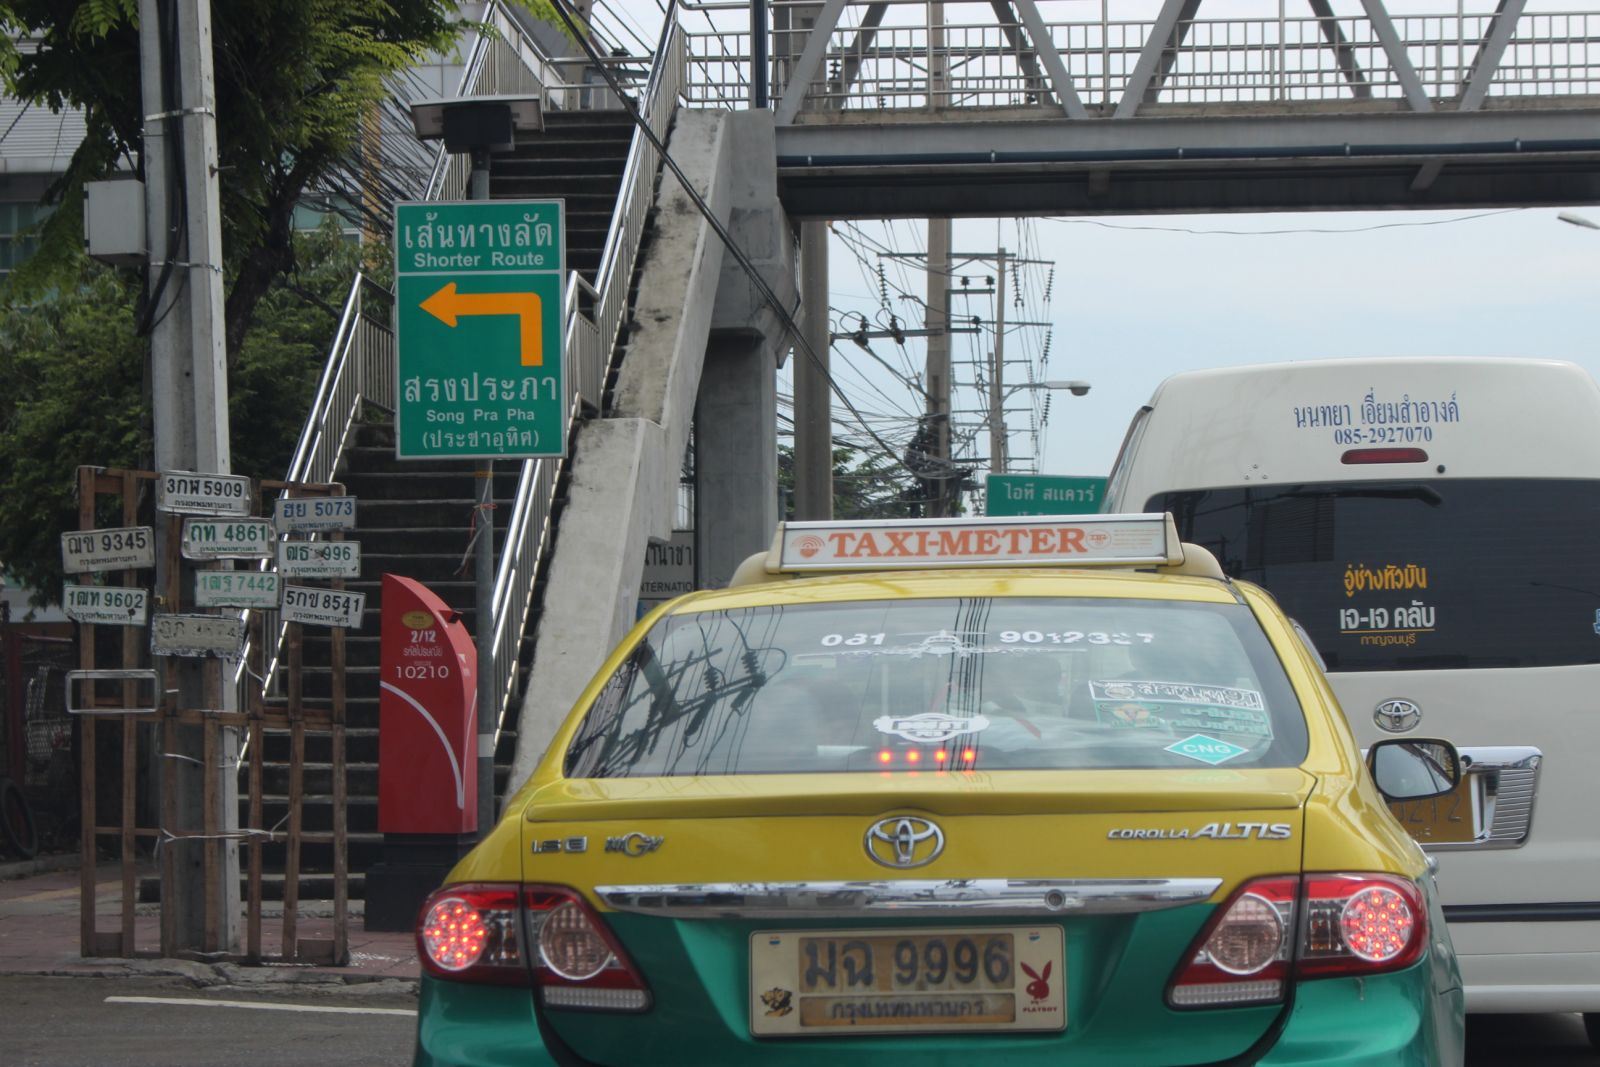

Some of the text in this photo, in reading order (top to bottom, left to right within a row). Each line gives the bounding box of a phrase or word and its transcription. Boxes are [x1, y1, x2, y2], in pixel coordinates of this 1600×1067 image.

[405, 212, 553, 248] เส้นทางลัด
[414, 251, 545, 268] Shorter Route
[404, 372, 557, 402] สรงประภา
[426, 408, 535, 424] Song Pra Pha
[1293, 387, 1460, 428] นนทยา เอี่ยมสำอางค์
[1334, 426, 1433, 444] 085-2927070
[203, 481, 243, 497] 5909
[1002, 482, 1096, 502] ไอที สแควร์
[315, 501, 353, 516] 5073
[223, 524, 267, 541] 4861
[101, 532, 147, 551] 9345
[828, 527, 1088, 558] TAXI-METER
[237, 576, 275, 592] 7442
[104, 592, 144, 609] 9602
[322, 594, 360, 613] 8541
[1340, 600, 1436, 629] เจ-เจ คลับ
[411, 630, 436, 643] 2/12
[1360, 633, 1417, 647] กาญจนบุรี
[396, 665, 449, 679] 10210
[1183, 744, 1232, 754] CNG
[1107, 822, 1291, 840] COROLLA ALTIS
[894, 937, 1010, 985] 9996
